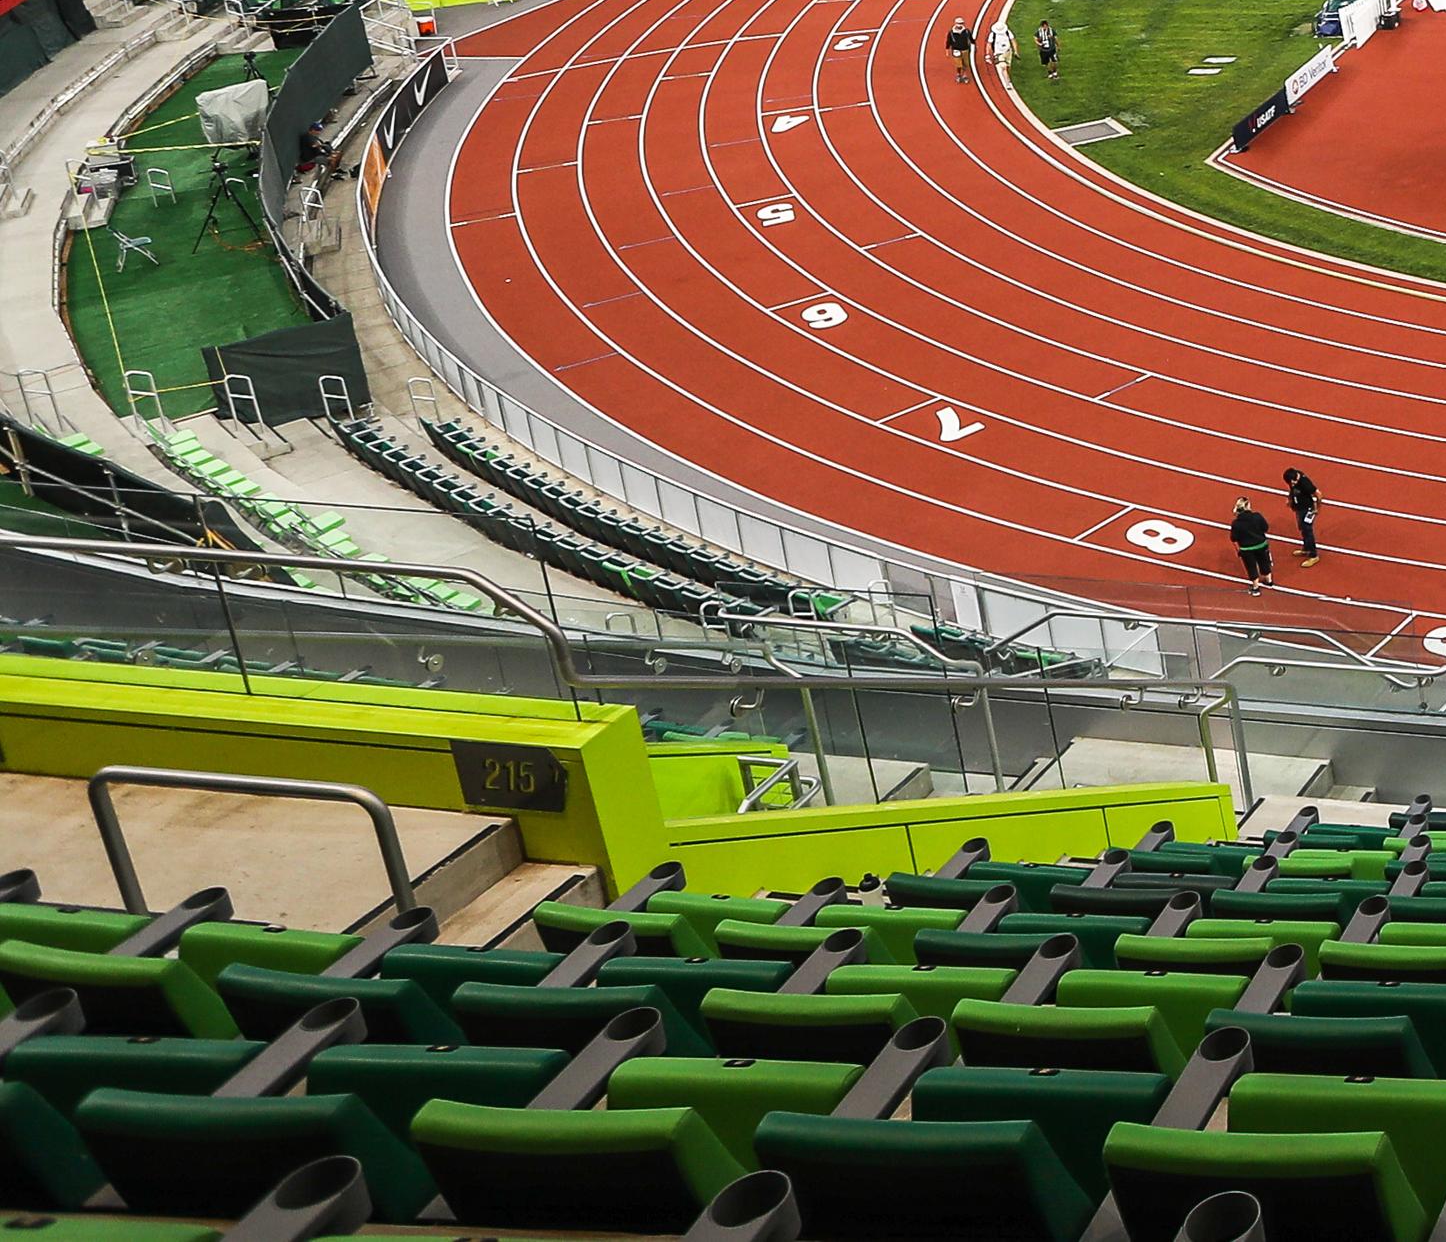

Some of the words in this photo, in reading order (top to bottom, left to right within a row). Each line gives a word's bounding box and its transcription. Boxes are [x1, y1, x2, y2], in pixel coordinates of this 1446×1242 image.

[833, 34, 870, 51] 3
[771, 114, 810, 134] 4
[1256, 105, 1276, 129] USATF
[756, 203, 796, 228] 5
[936, 405, 986, 443] 7
[1125, 518, 1195, 556] 8
[484, 758, 536, 793] 215
